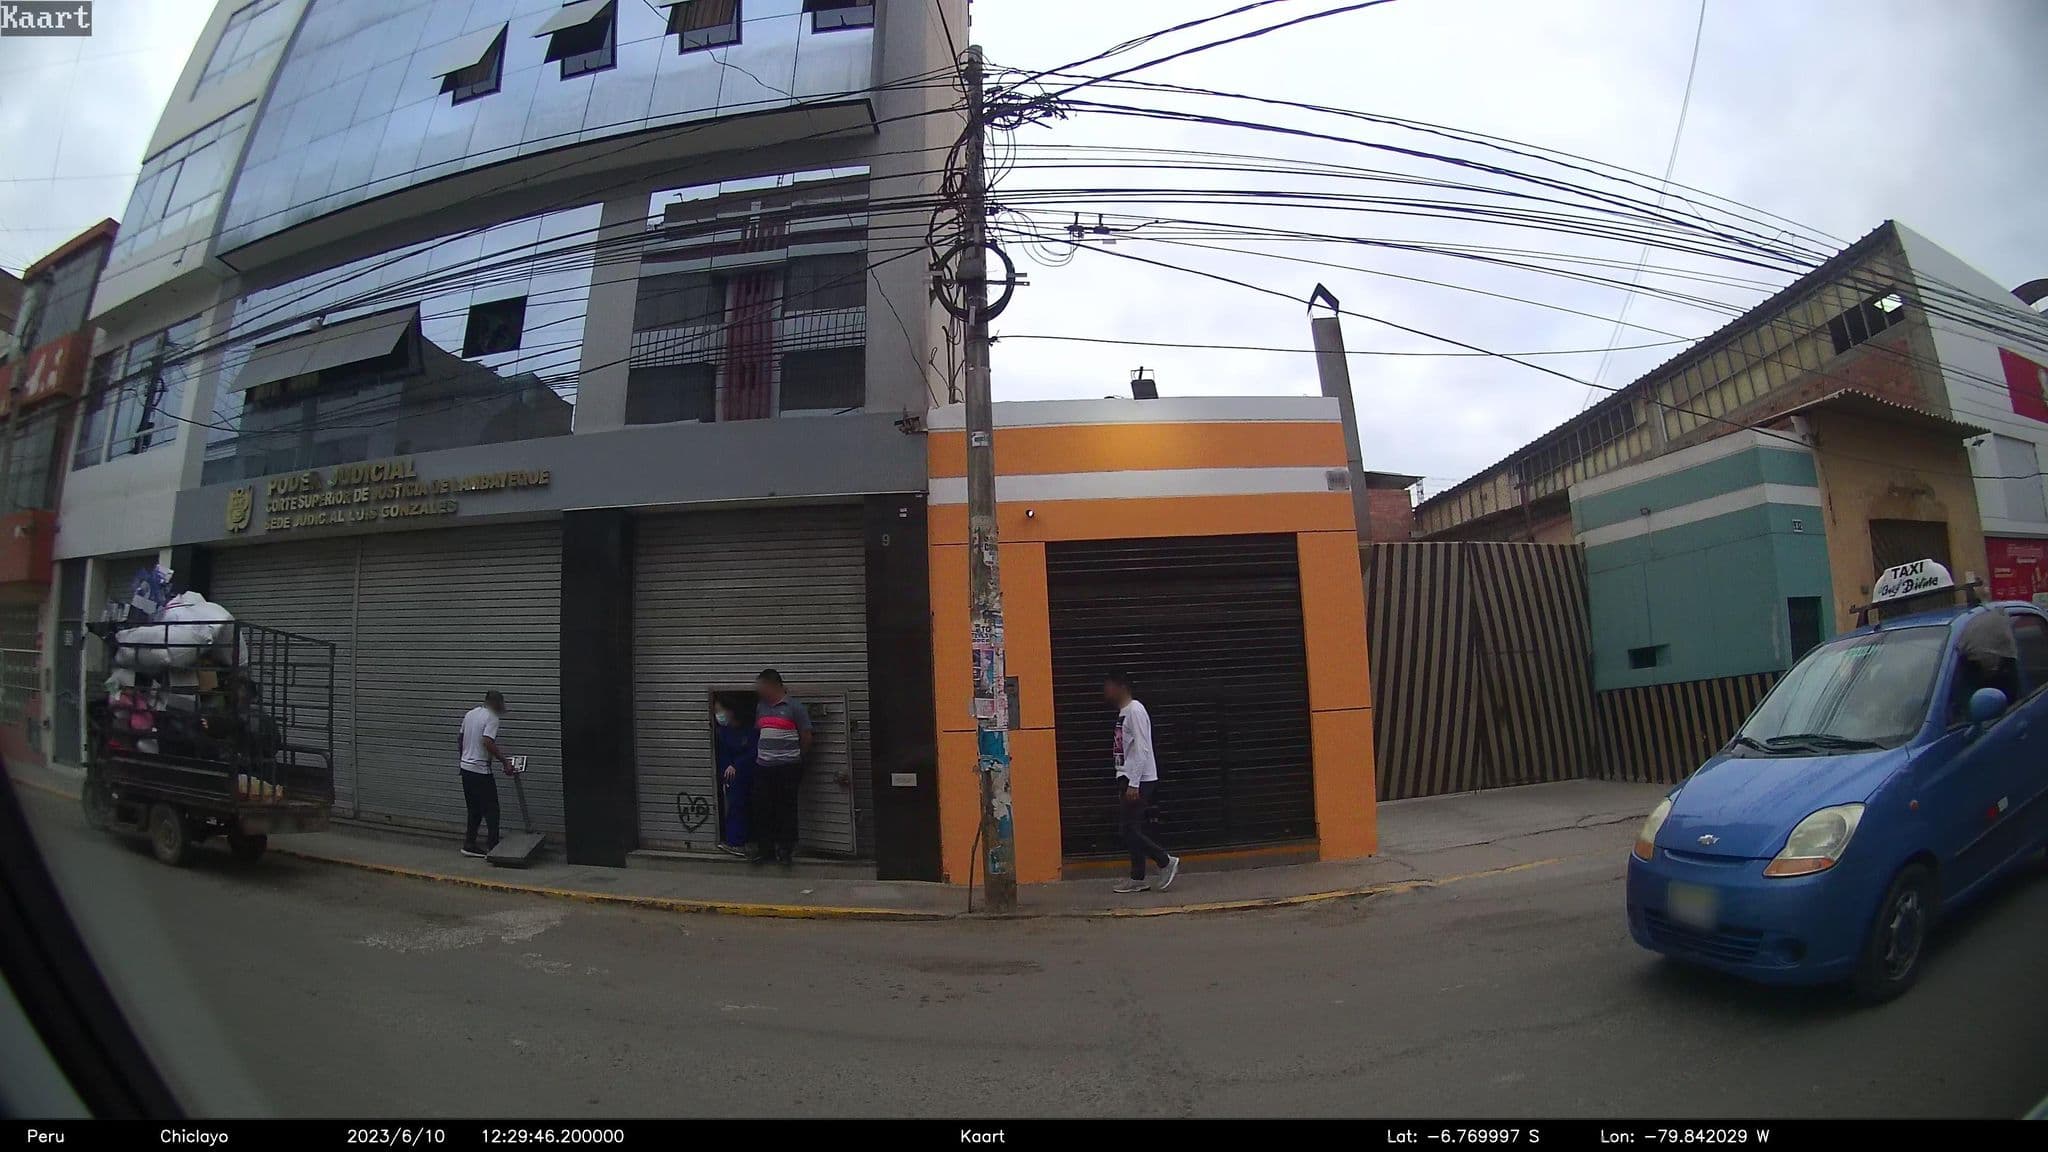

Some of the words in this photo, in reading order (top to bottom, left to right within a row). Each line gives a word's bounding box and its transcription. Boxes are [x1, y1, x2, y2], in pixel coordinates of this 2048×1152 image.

[328, 457, 416, 486] JUDICIAL
[265, 495, 298, 513] CORTE
[353, 487, 369, 503] DE
[449, 467, 551, 492] LAMBAYEQUE
[264, 516, 291, 530] SEDE
[293, 510, 345, 527] JUDICIAL
[346, 508, 378, 521] LUIS
[382, 496, 458, 518] GONZALES
[1892, 561, 1924, 580] TAXI
